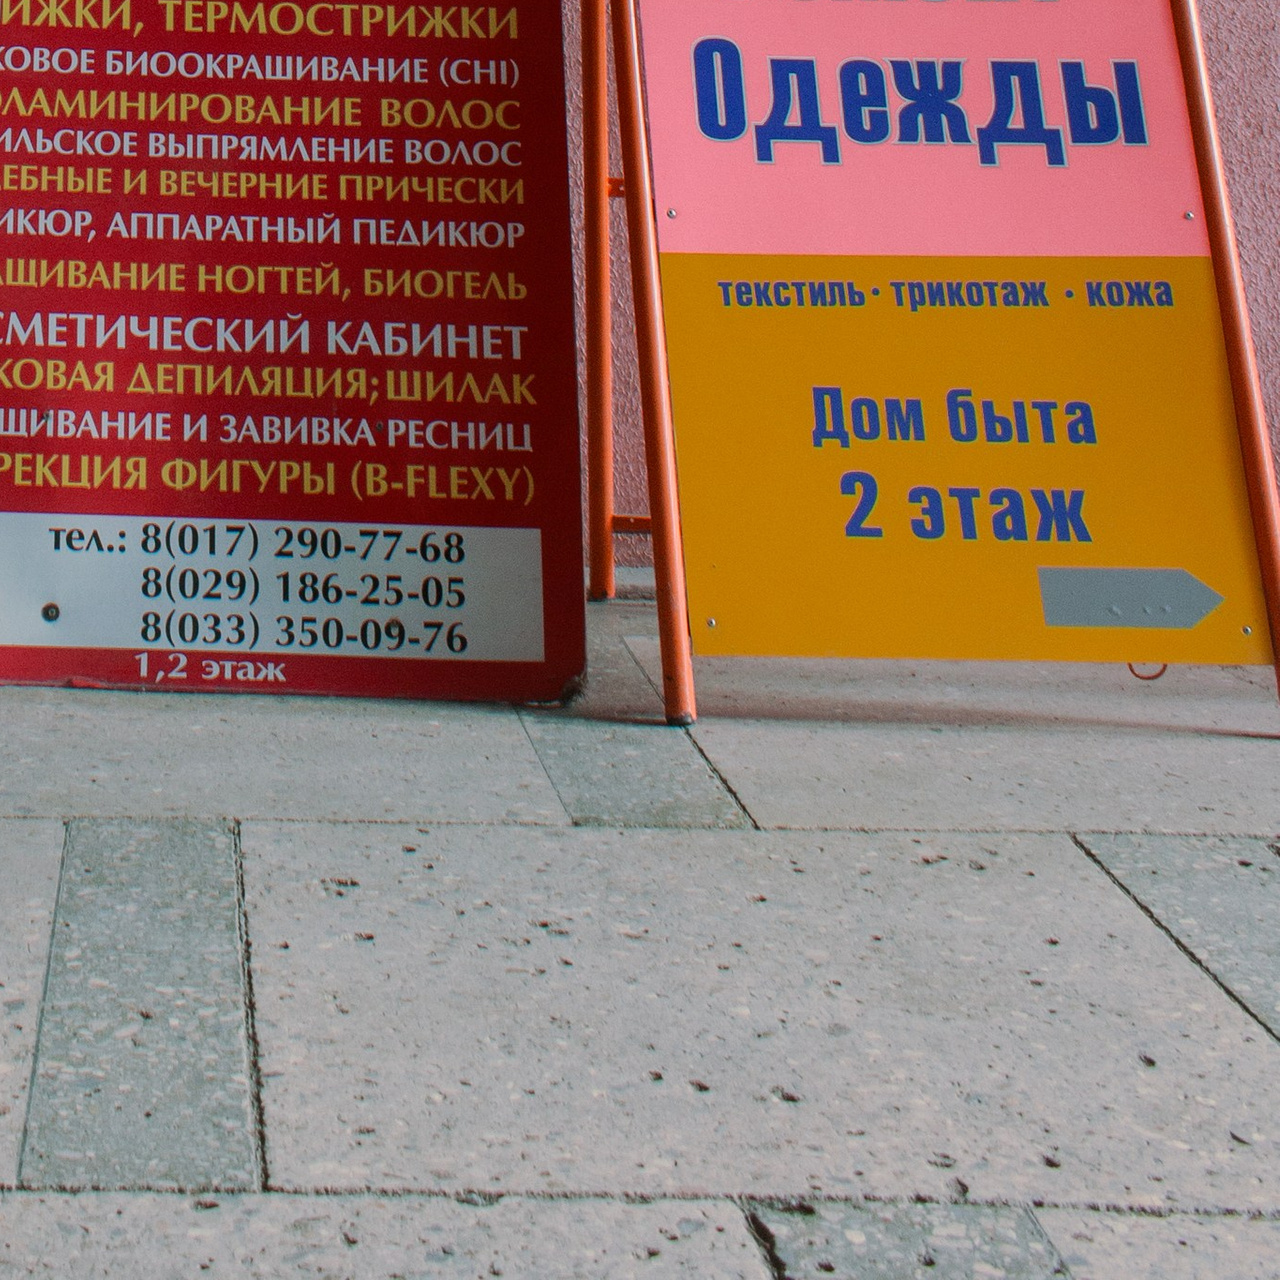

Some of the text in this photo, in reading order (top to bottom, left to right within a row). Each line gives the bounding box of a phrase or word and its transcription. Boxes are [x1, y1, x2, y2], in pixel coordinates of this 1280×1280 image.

[105, 49, 428, 85] БИООКРАШИВАНИЕ
[439, 57, 520, 89] (CHI)
[380, 98, 521, 131] ВОЛОС
[691, 34, 1149, 167] Одежды
[148, 132, 393, 165] ВЫПРЯМЛЕНИЕ
[404, 140, 523, 167] ВОЛОС
[123, 168, 148, 195] И
[160, 169, 328, 201] ВЕЧЕРНИЕ
[339, 175, 526, 206] ПРИЧЕСКИ
[106, 212, 341, 246] АППАРАТНЫЙ
[352, 218, 526, 249] ПЕДИКЮР
[197, 261, 351, 301] НОГТЕЙ,
[364, 268, 528, 301] БИОГЕЛЬ
[718, 279, 1175, 312] текстиль трикотаж кожа
[327, 321, 529, 361] КАБИНЕТ
[126, 362, 380, 405] ДЕПИЛЯЦИЯ;
[385, 369, 537, 406] ШИЛАК
[182, 414, 209, 443] И
[219, 414, 376, 447] ЗАВИВКА
[387, 419, 533, 453] РЕСНИЦ
[811, 385, 1099, 449] Дом быта
[161, 455, 336, 497] ФИГУРЫ
[350, 460, 535, 506] (B-FLEXY)
[839, 469, 1094, 544] 2 этаж
[48, 521, 466, 565] тел.: 8(017) 290-77-68
[140, 565, 467, 609] 8(029) 186-25-05
[140, 608, 469, 655] 8(033) 350-09-76
[134, 651, 287, 684] 1,2 этаж
